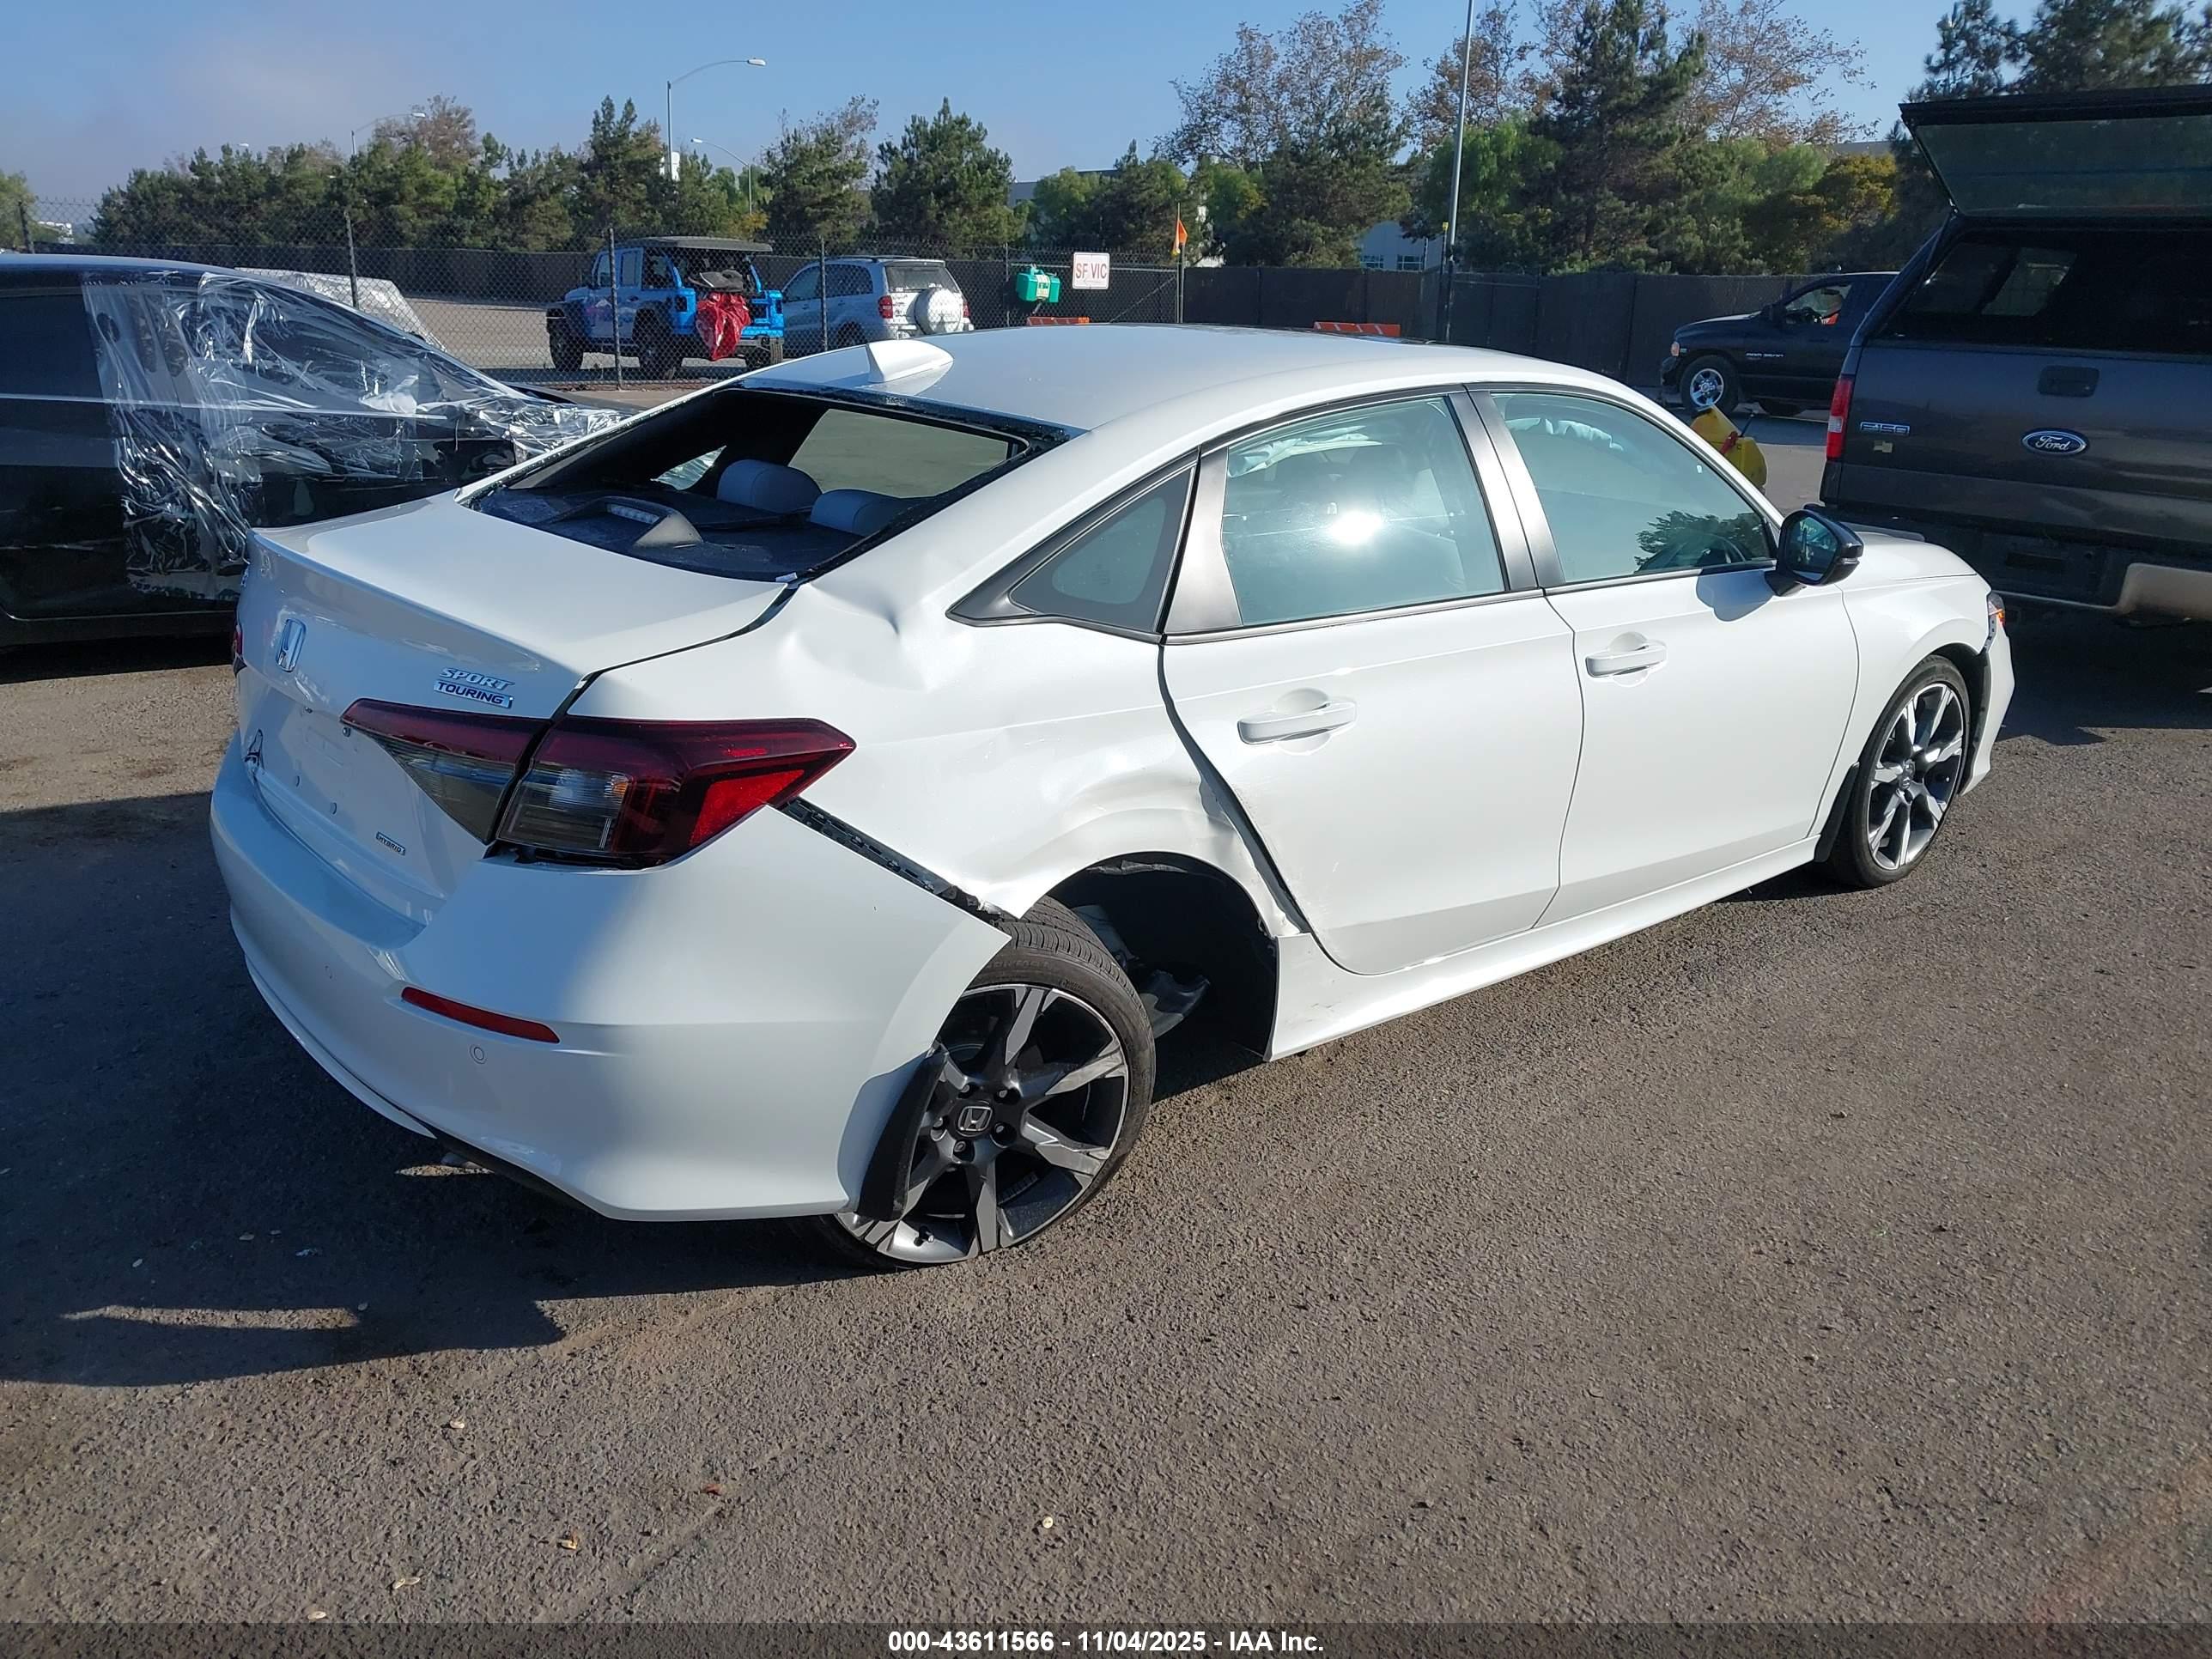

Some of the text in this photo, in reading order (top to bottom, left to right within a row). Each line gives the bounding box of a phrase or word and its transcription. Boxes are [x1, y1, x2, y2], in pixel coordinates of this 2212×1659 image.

[1075, 263, 1107, 279] SF VIC
[2035, 435, 2070, 450] Ford
[439, 667, 515, 690] SPORT
[437, 681, 505, 704] TOURING
[379, 836, 402, 853] HYBRID
